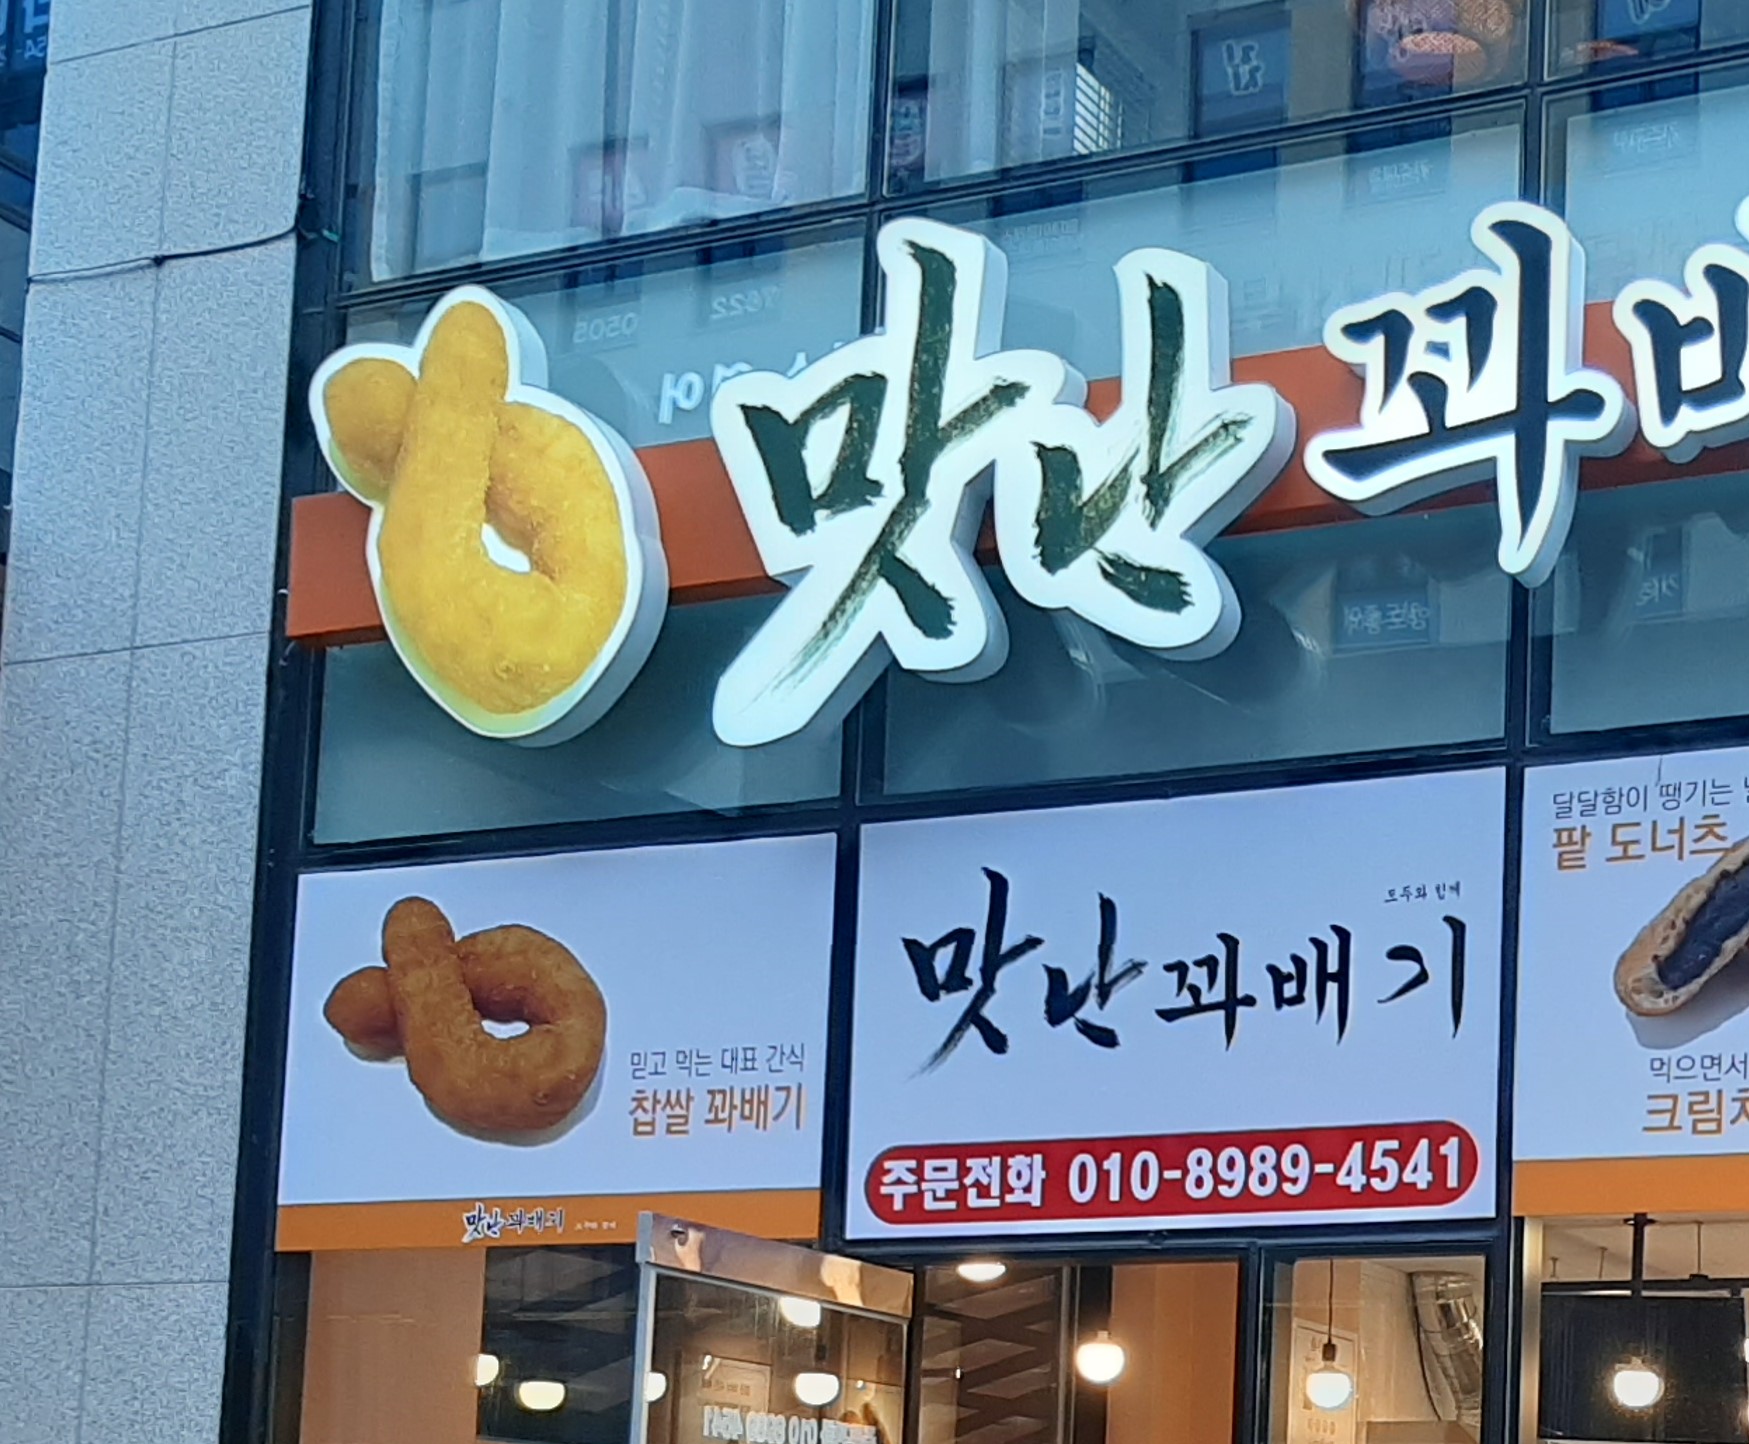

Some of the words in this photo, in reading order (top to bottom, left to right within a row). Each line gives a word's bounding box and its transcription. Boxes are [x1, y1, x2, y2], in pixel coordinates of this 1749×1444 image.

[735, 240, 1254, 702] 맛난
[1552, 784, 1649, 820] 달달함이
[1658, 777, 1735, 812] 땡기는
[1551, 823, 1592, 871] 팥
[1605, 813, 1734, 863] 도너츠
[901, 866, 1148, 1081] 맛난
[1155, 914, 1467, 1051] 꽈배기
[630, 1050, 667, 1081] 믿고
[675, 1047, 714, 1078] 먹는
[720, 1046, 759, 1076] 대표
[765, 1041, 806, 1074] 간식
[628, 1087, 695, 1137] 찹쌀
[704, 1081, 803, 1134] 꽈배기
[878, 1150, 1047, 1213] 주문전화
[1067, 1135, 1462, 1204] 010-8989-4541
